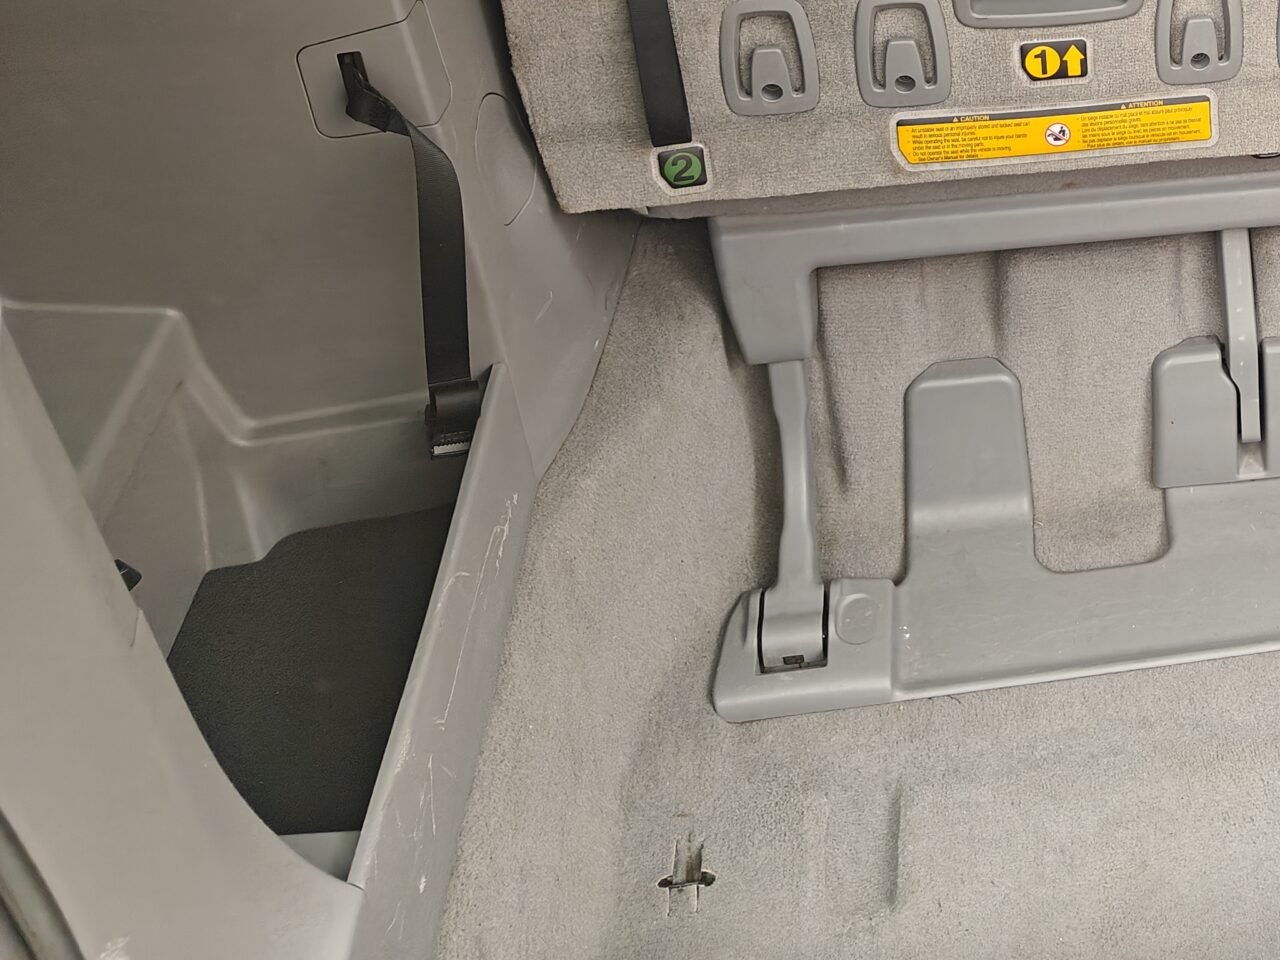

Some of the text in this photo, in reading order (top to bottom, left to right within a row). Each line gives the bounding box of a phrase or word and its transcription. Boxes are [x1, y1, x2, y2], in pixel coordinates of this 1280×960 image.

[1034, 50, 1048, 75] 1
[1128, 100, 1164, 108] ATTENTION
[672, 154, 694, 182] 2
